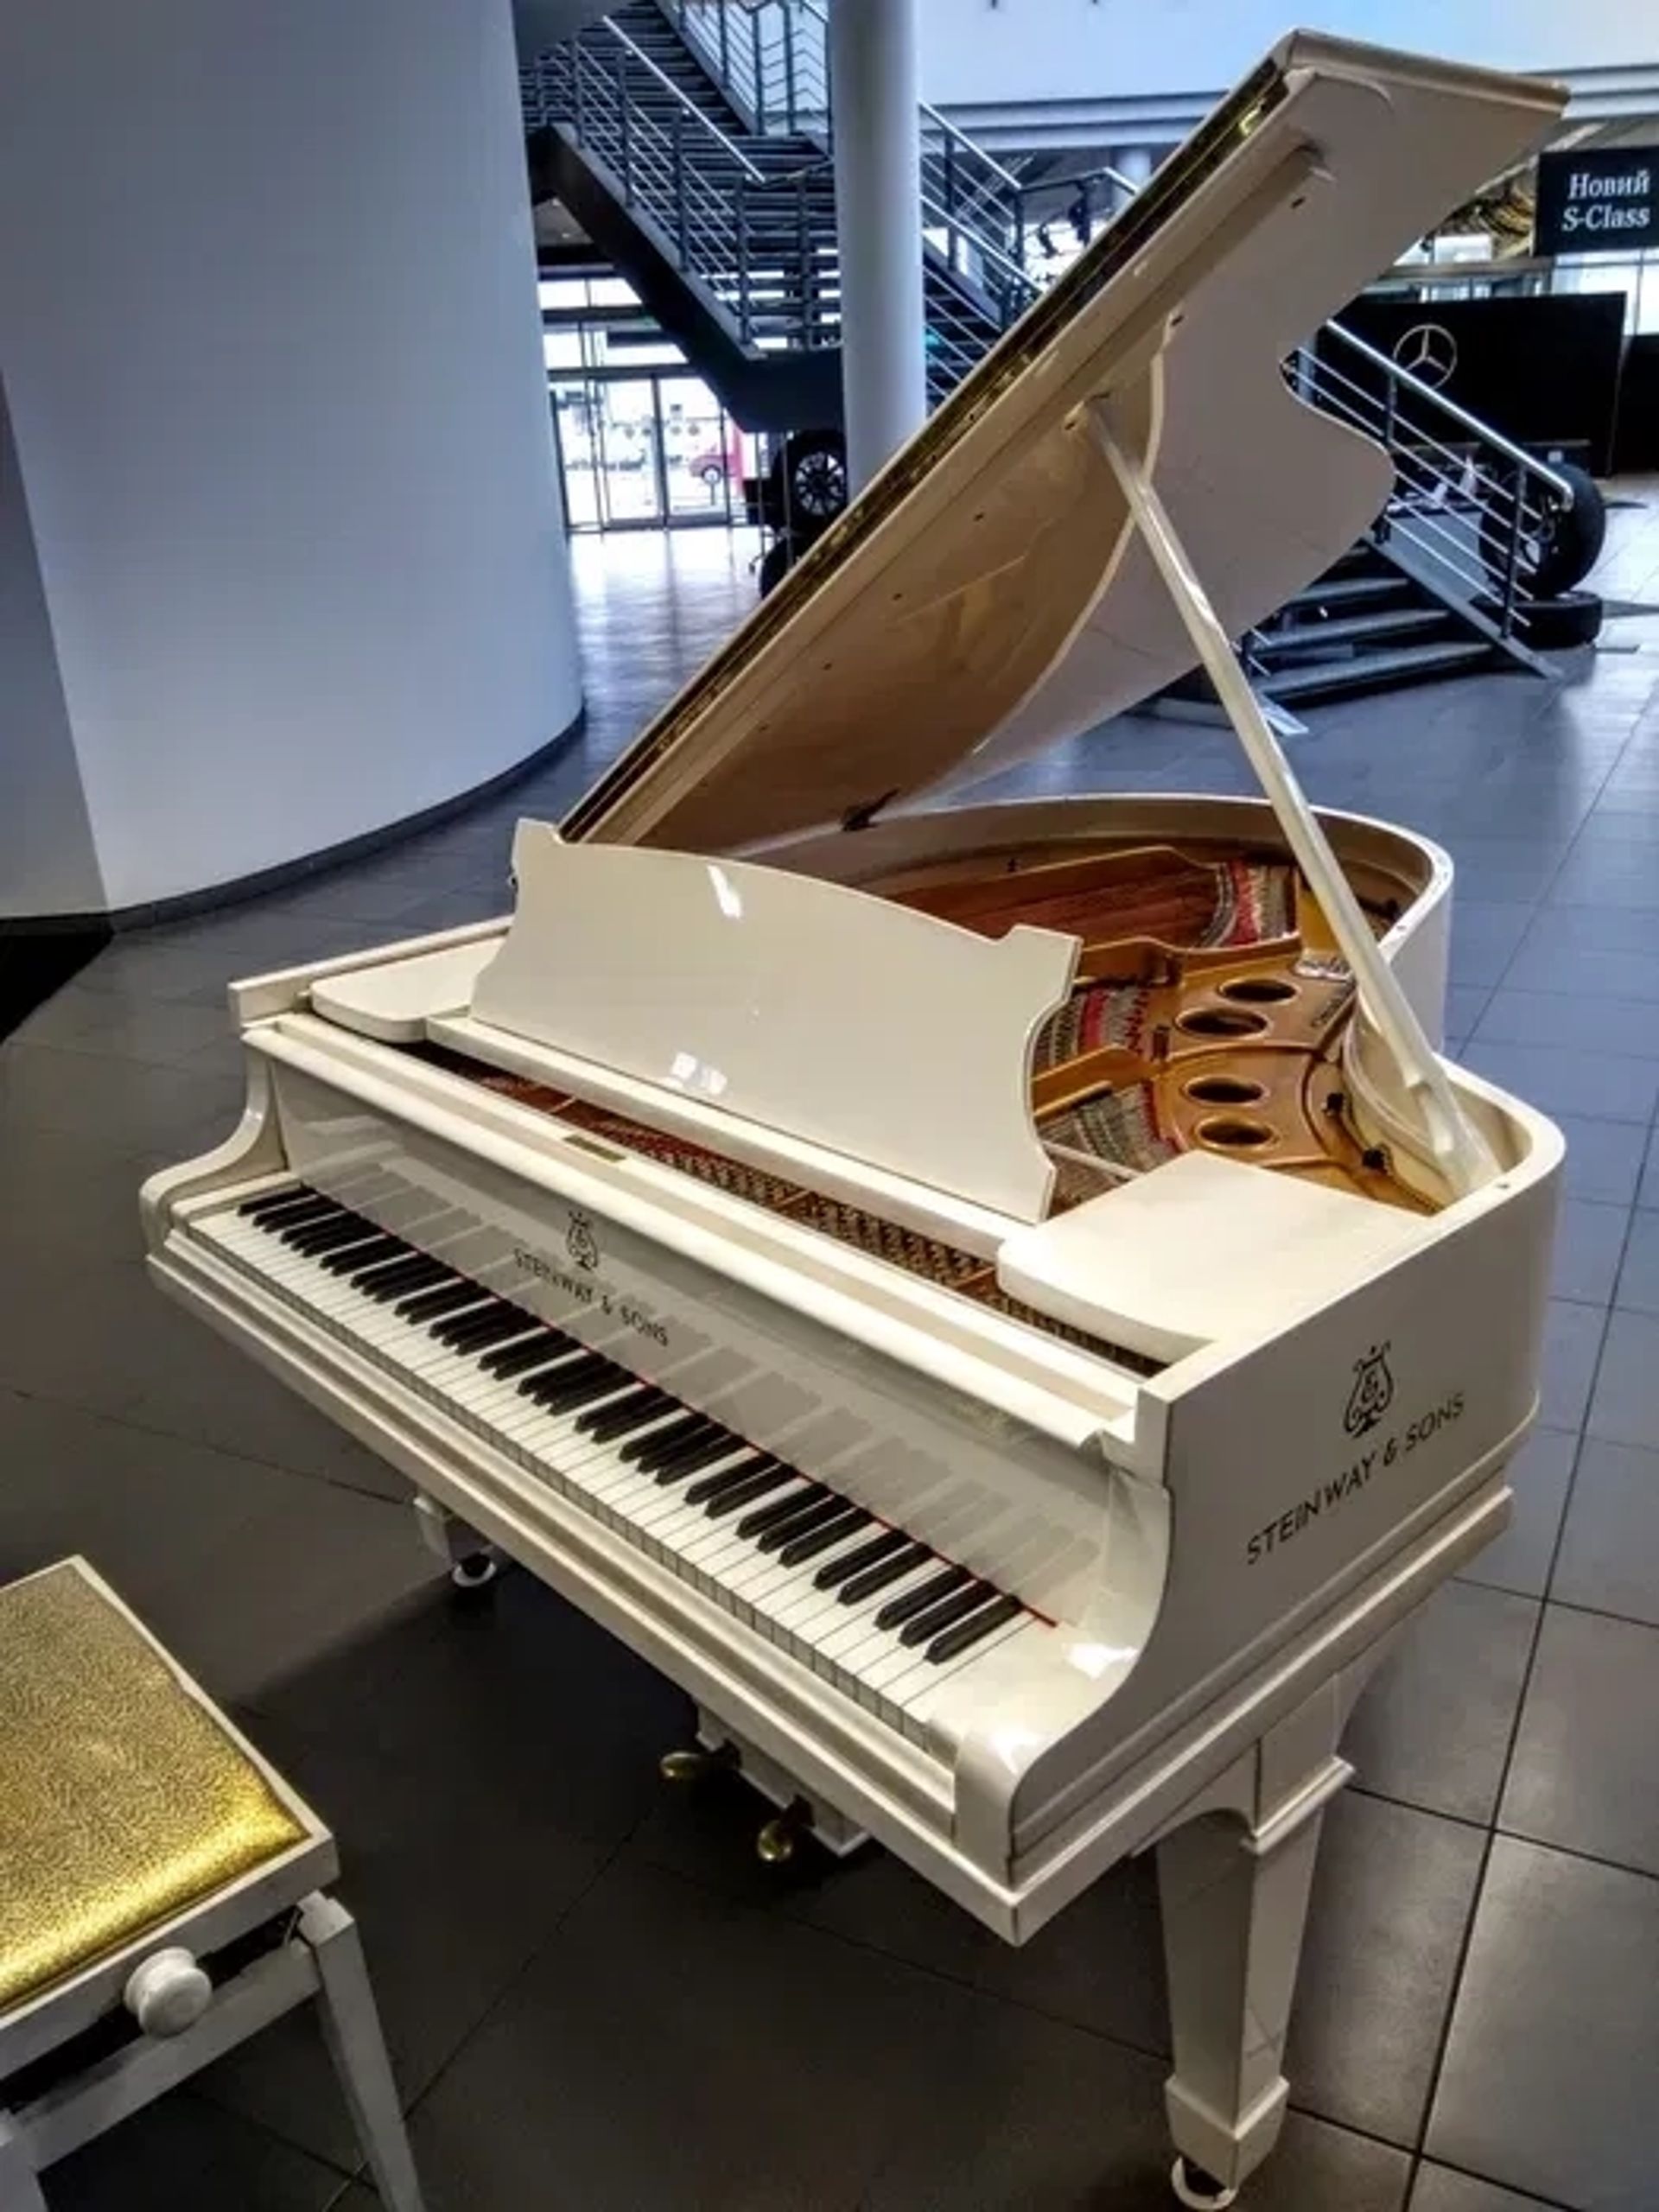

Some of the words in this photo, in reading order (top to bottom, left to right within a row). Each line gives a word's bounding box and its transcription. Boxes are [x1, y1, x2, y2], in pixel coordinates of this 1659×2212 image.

[1567, 168, 1650, 200] Новий
[1561, 203, 1650, 232] S-Class
[620, 1306, 669, 1346] SONS
[1247, 1449, 1377, 1565] STEINWAY
[1383, 1437, 1397, 1467] &
[1405, 1391, 1465, 1452] SONS
